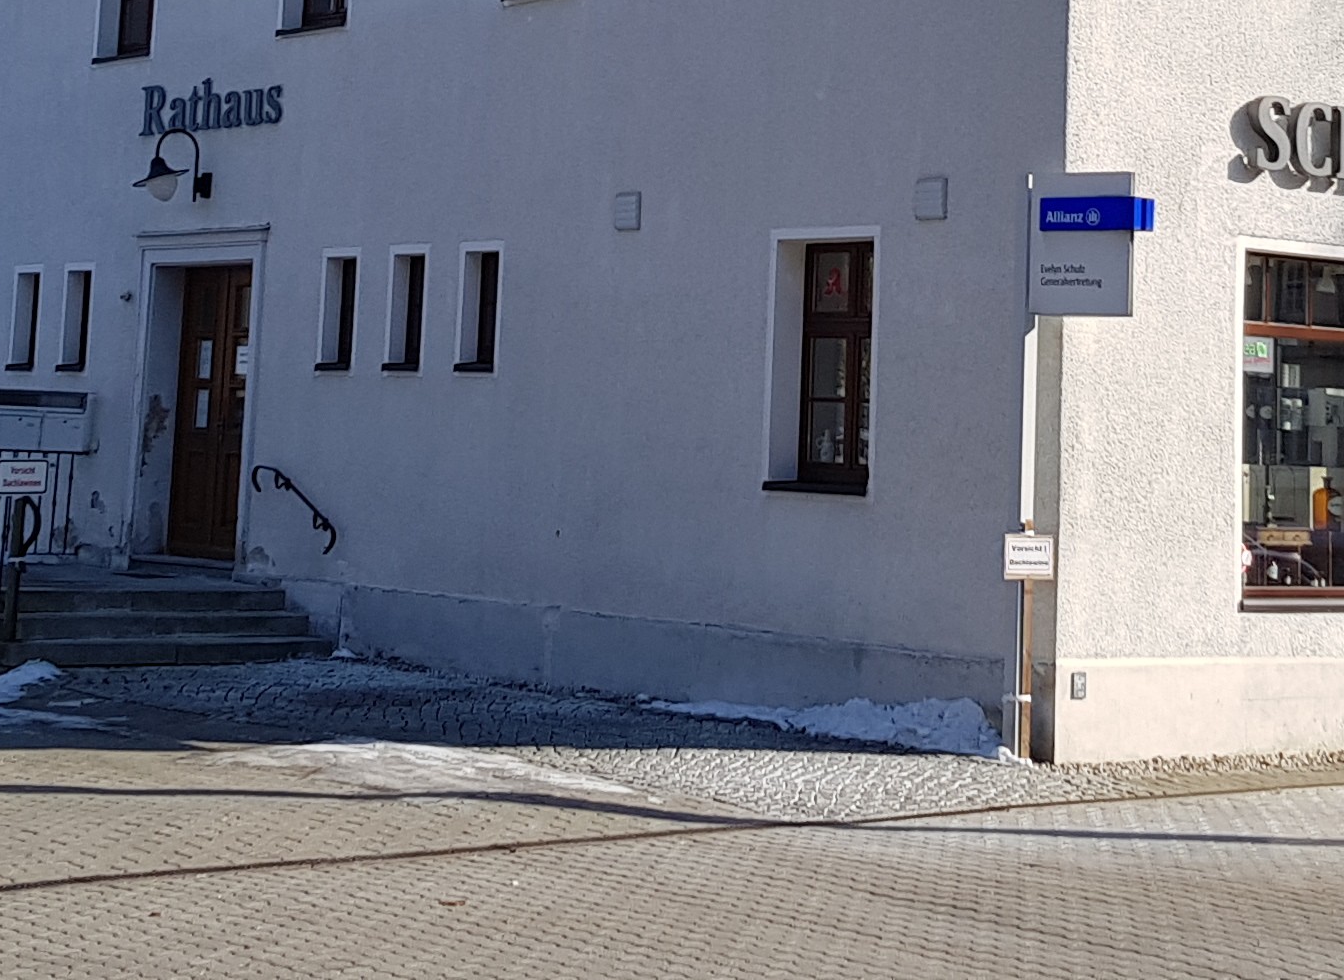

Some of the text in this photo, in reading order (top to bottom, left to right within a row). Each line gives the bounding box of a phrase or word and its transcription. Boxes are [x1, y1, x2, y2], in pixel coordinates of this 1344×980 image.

[139, 77, 284, 136] Rathaus
[1046, 210, 1084, 223] Allianz
[1040, 276, 1102, 288] Generalvertretung
